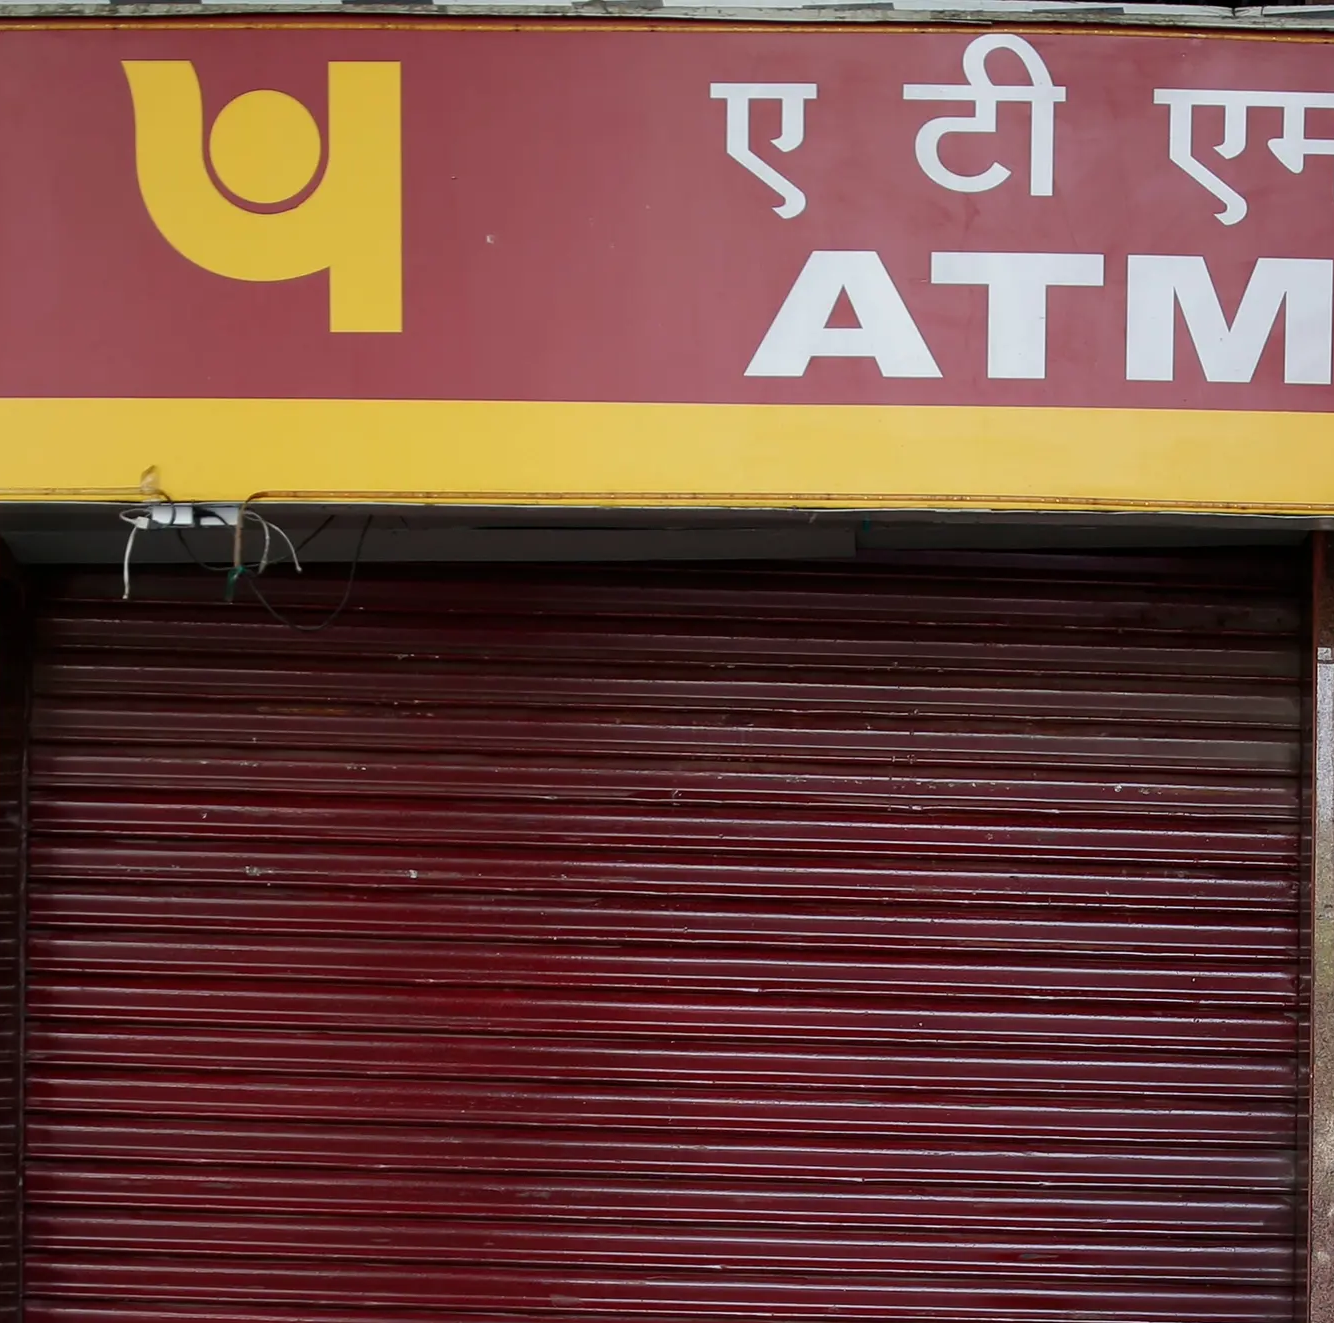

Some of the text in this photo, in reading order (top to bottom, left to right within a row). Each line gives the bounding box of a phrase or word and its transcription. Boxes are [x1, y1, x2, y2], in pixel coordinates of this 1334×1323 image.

[710, 83, 817, 219] ए
[903, 29, 1066, 196] टी
[744, 251, 1333, 384] ATM
